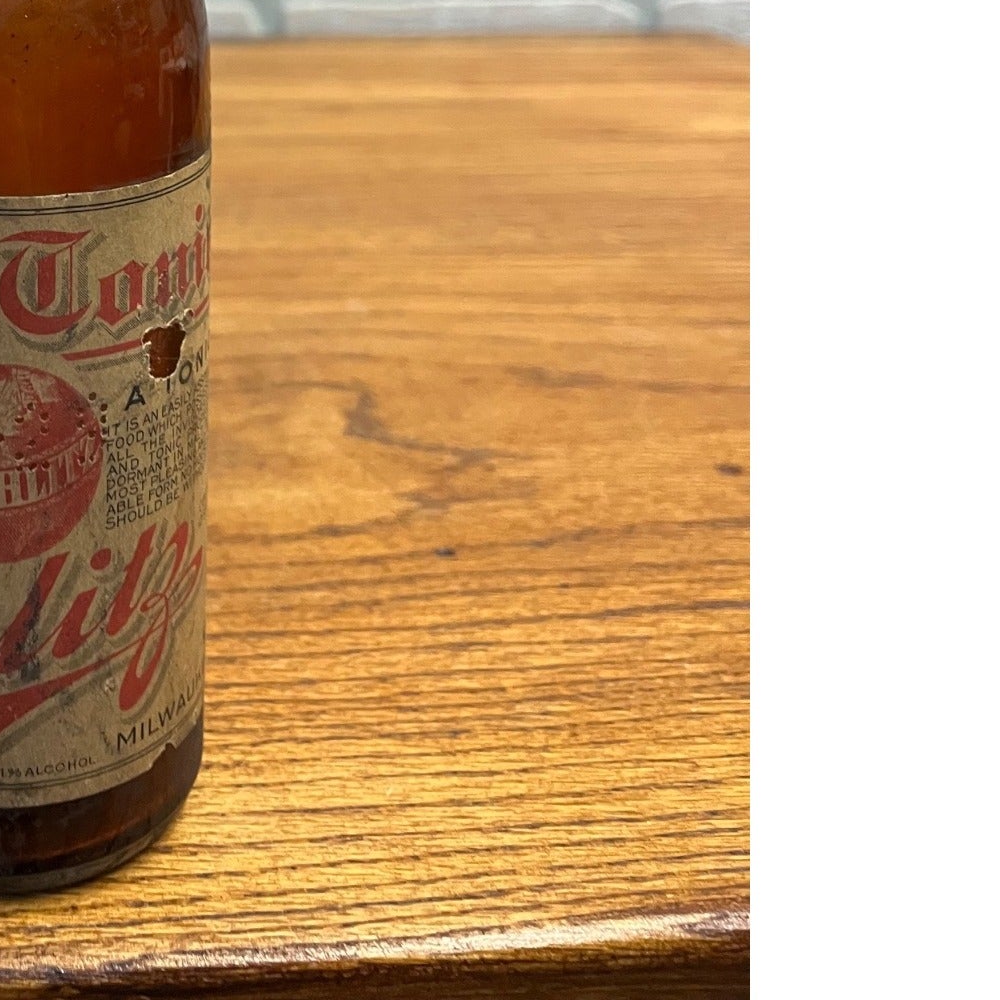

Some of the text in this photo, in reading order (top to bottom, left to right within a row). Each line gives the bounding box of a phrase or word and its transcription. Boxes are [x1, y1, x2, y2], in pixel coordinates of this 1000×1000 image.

[123, 384, 146, 411] A
[126, 416, 140, 433] IS
[142, 408, 159, 427] AN
[106, 430, 145, 451] FOOD
[106, 432, 166, 464] ALL THE
[106, 457, 140, 478] AND
[148, 435, 182, 464] TONIC
[106, 456, 170, 491] DORMANT
[106, 479, 147, 503] MOST
[106, 494, 145, 517] ABLE
[148, 475, 179, 502] FORM
[105, 487, 181, 530] SHOULD BE
[24, 756, 98, 778] ALCOHOL
